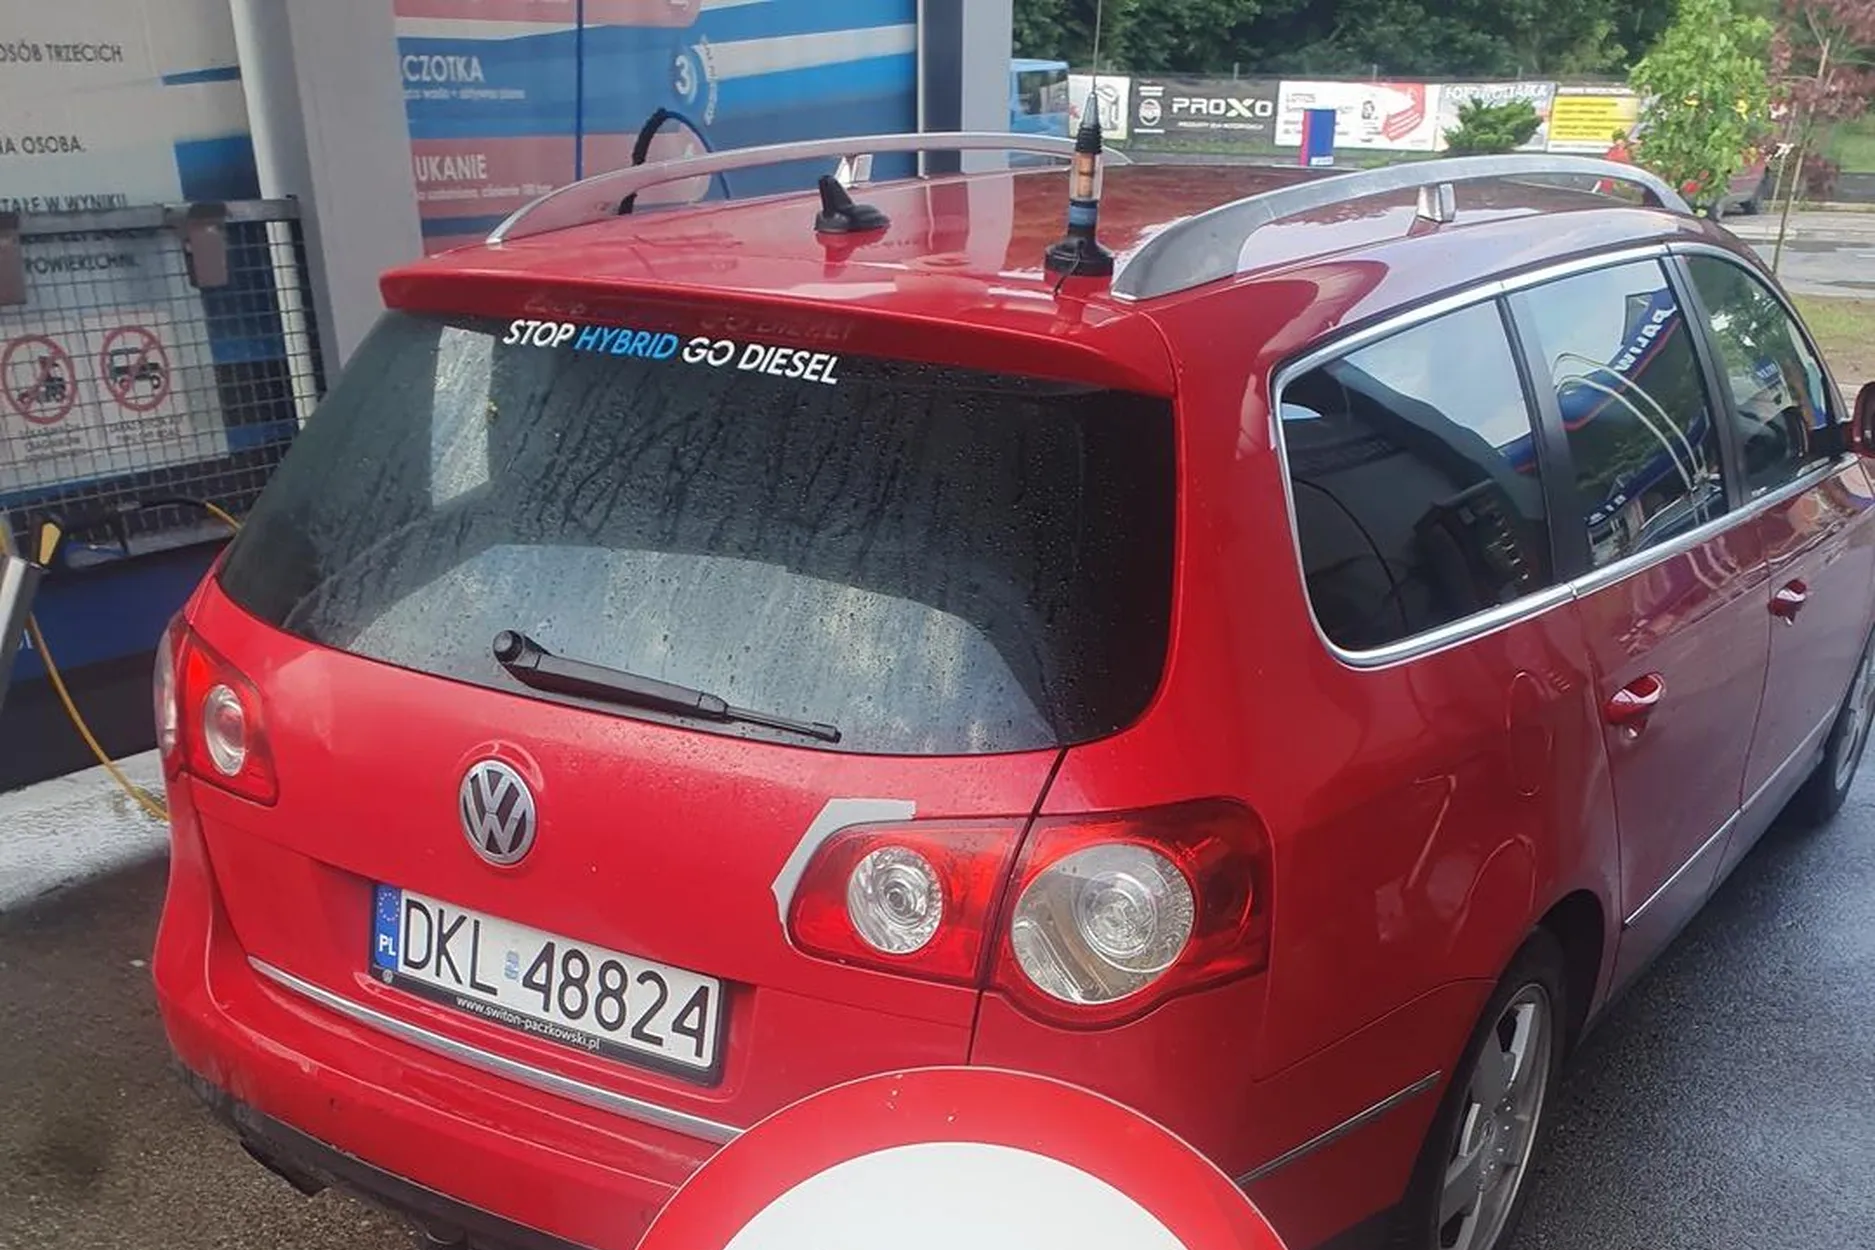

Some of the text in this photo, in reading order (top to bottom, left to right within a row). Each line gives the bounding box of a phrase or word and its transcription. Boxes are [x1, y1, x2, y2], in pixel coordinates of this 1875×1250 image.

[44, 42, 124, 62] TRZECICH
[1172, 97, 1273, 118] PROXO
[503, 319, 842, 385] STOP HYBRID GO DIESEL
[378, 934, 397, 957] PL
[403, 898, 711, 1058] DKL 48824
